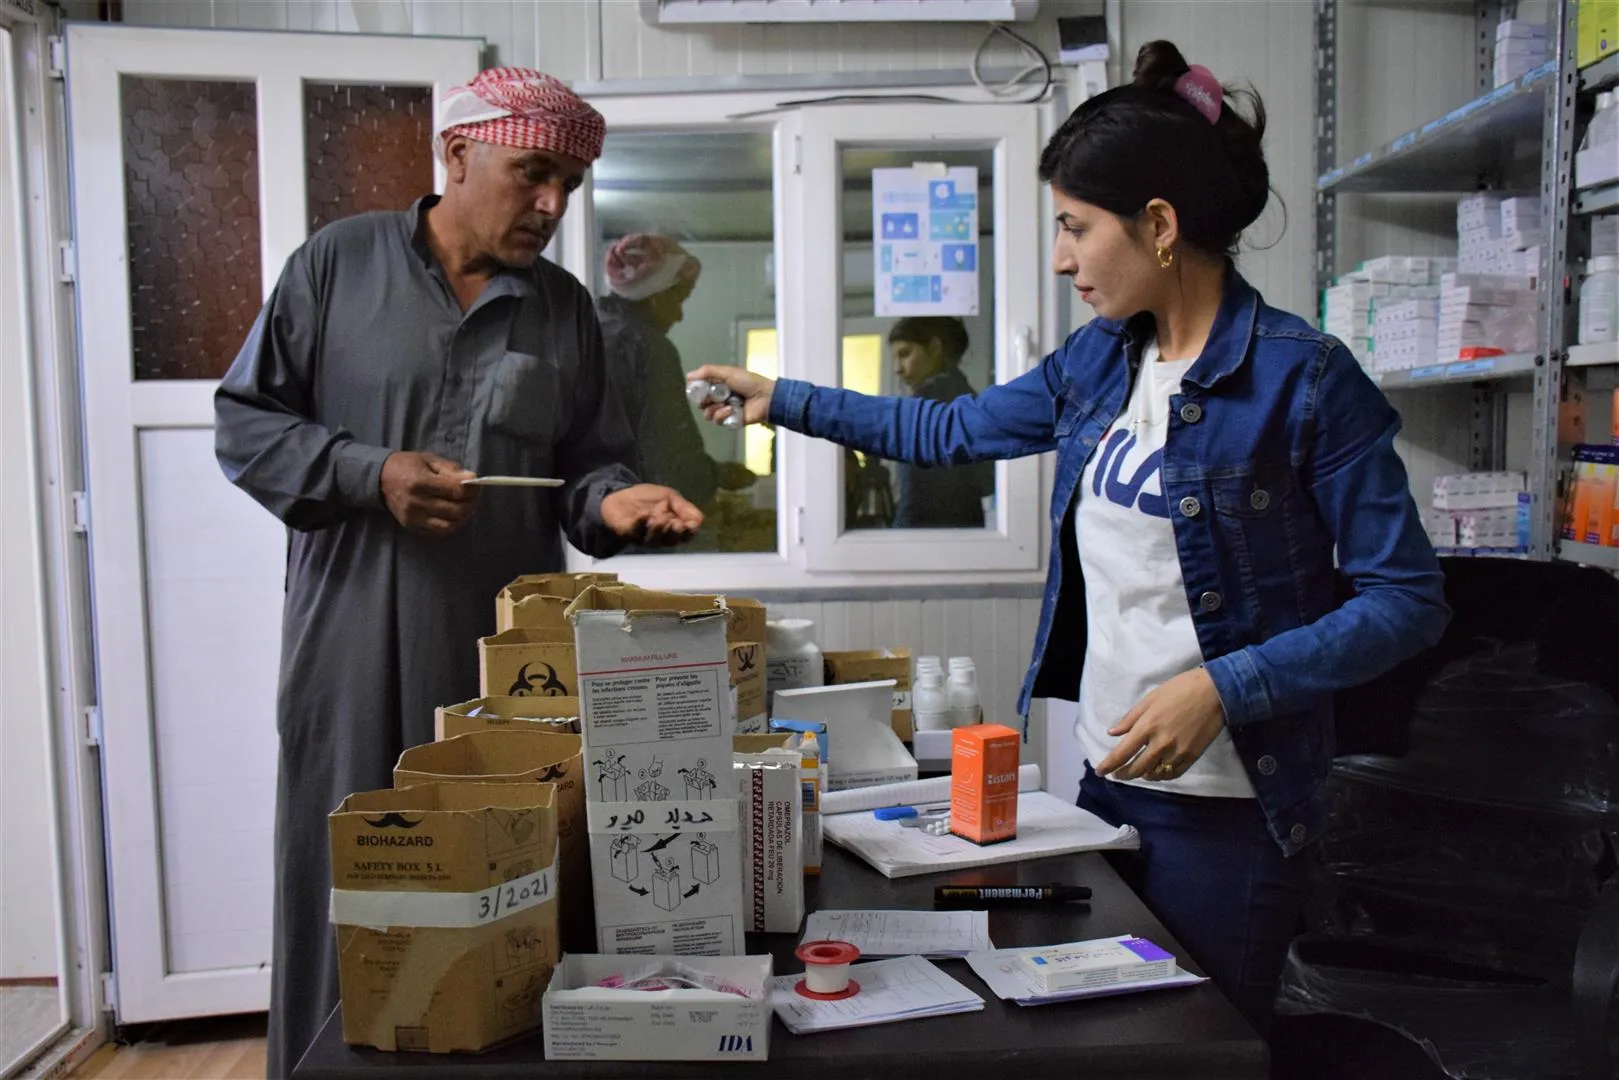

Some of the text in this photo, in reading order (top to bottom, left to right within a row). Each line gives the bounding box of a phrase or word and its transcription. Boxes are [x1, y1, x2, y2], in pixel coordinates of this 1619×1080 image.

[1093, 428, 1171, 519] ILA
[356, 835, 434, 848] BIOHAZARD
[776, 840, 783, 850] DE
[354, 862, 443, 872] SAFETY BOX 5 L
[768, 860, 775, 869] 20
[768, 870, 774, 880] mg
[478, 873, 548, 919] 3/2021
[979, 888, 1042, 900] Permanent
[718, 1034, 753, 1052] IDA
